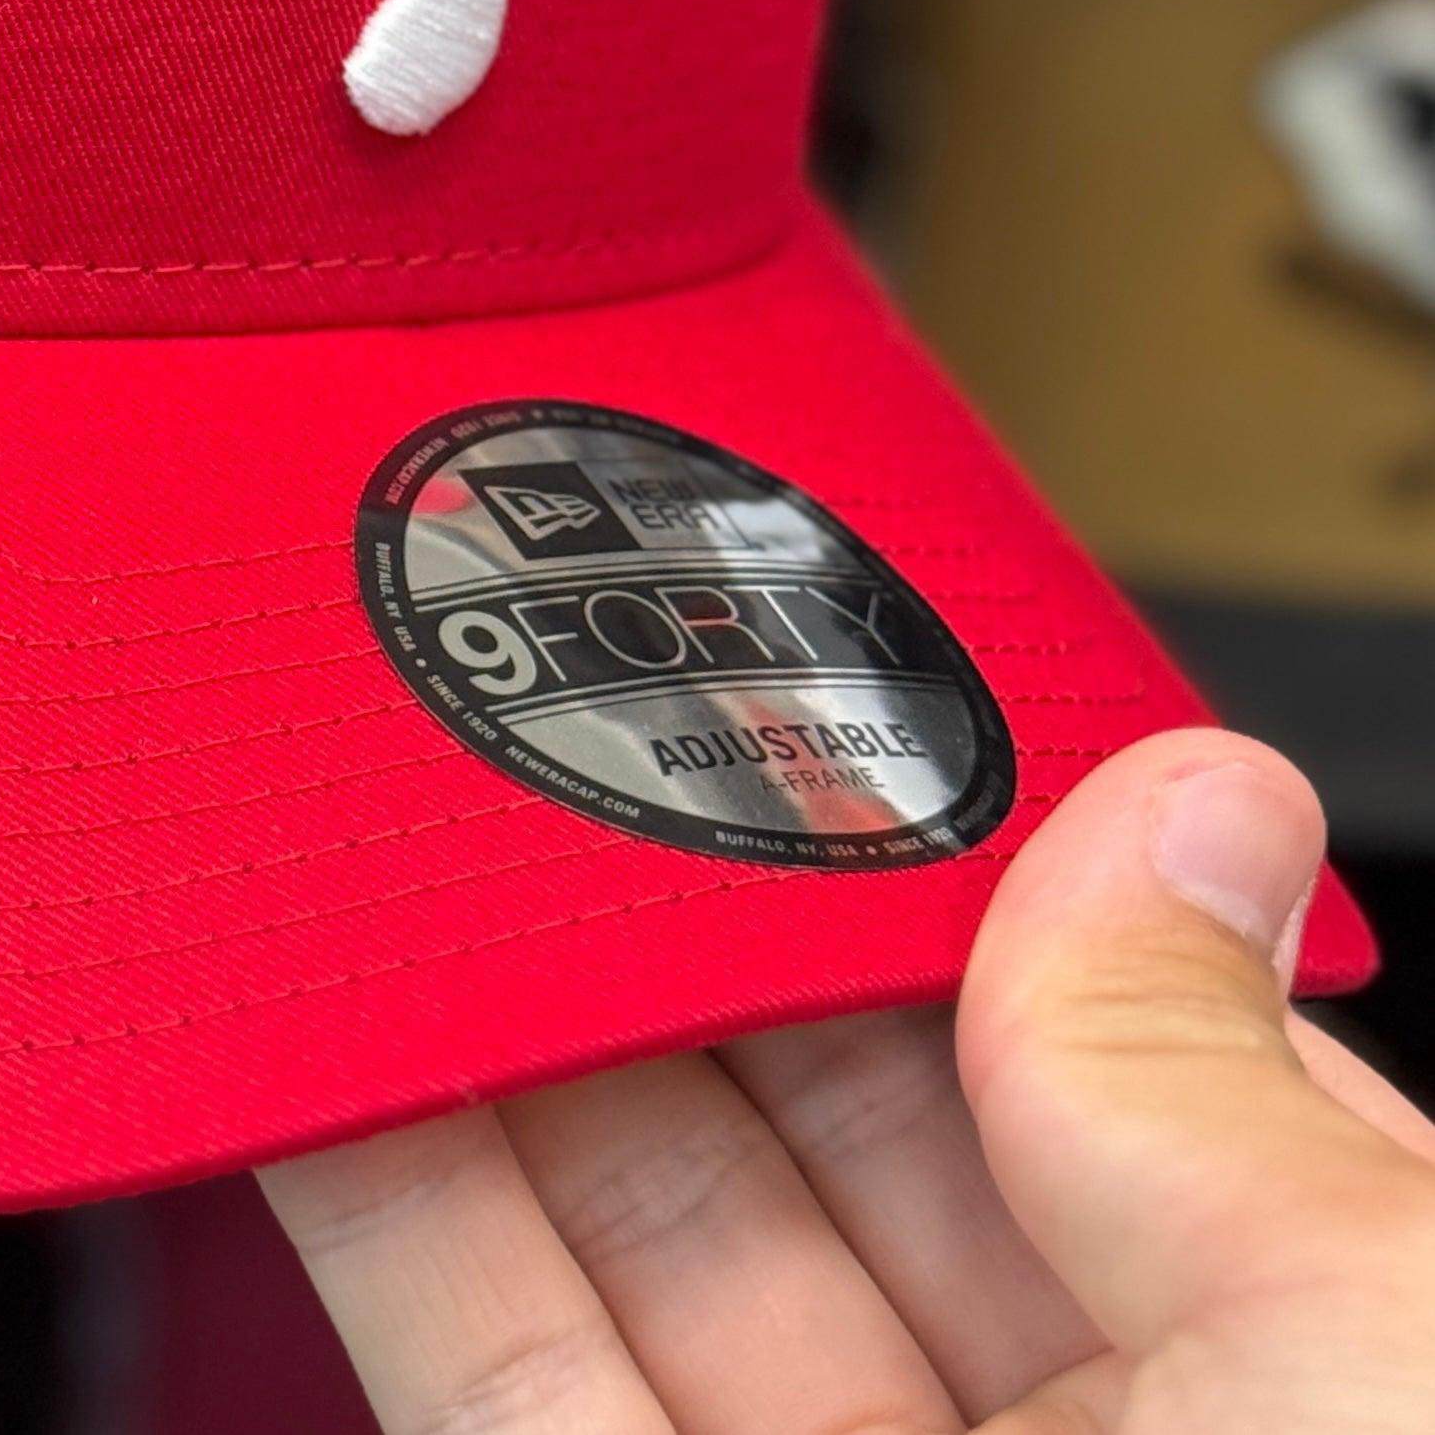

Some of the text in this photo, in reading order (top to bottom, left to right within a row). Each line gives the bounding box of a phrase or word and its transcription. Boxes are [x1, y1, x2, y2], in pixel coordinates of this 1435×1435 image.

[629, 503, 720, 530] ERA
[437, 585, 900, 696] 9FORTY
[394, 626, 417, 652] USA
[426, 674, 464, 711] SINCE
[462, 711, 498, 741] 1920
[505, 745, 641, 818] NEWERACAP.COM
[650, 722, 928, 776] ADJUSTABLE
[760, 768, 886, 792] A-FRAME
[715, 830, 792, 855] BUFFALO,
[826, 844, 858, 856] USA
[883, 836, 925, 854] SINCE
